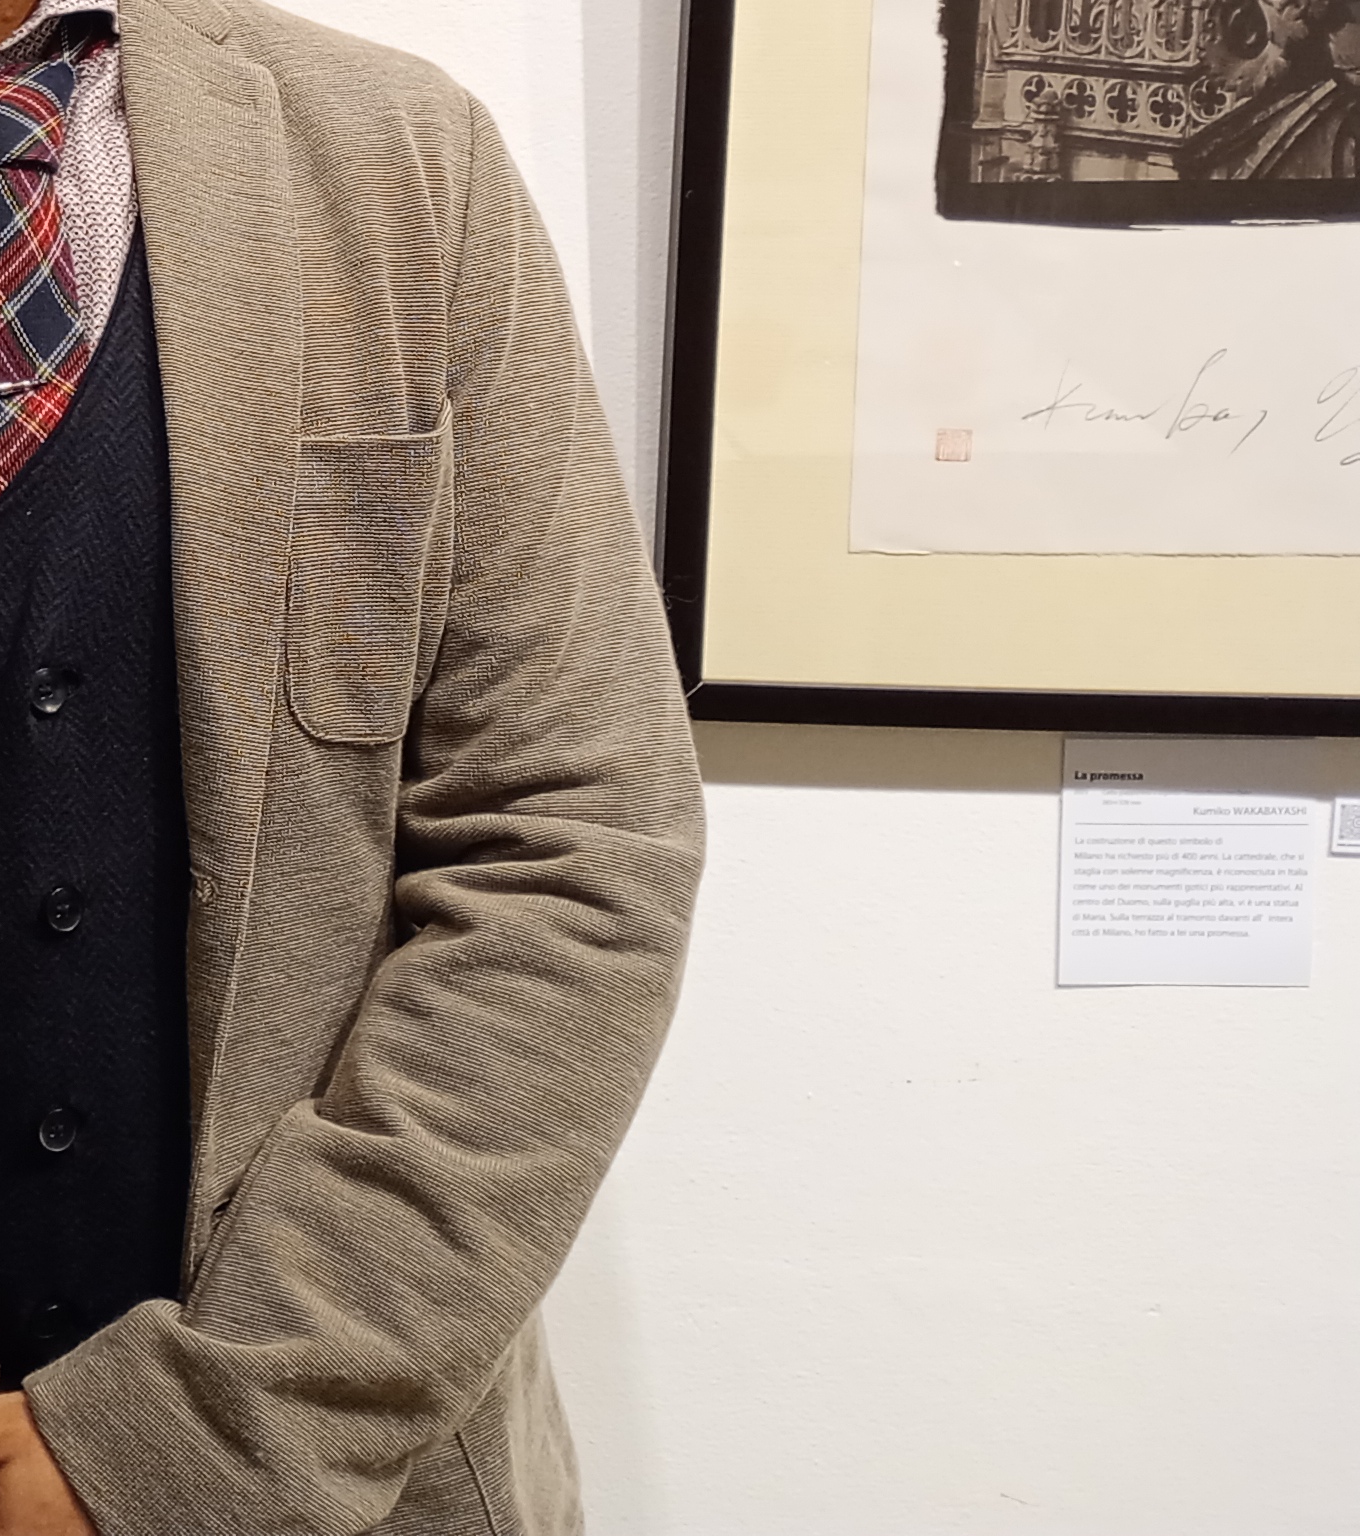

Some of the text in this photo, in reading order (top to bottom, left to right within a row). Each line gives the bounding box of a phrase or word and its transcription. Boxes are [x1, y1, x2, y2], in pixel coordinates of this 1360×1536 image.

[1074, 771, 1144, 781] La promessa
[1193, 807, 1307, 815] Kumiko WAKABAYASHI
[1148, 838, 1176, 846] questo
[1074, 852, 1102, 860] Milano
[1156, 853, 1169, 861] più
[1185, 884, 1208, 892] gotici
[1210, 884, 1224, 892] più
